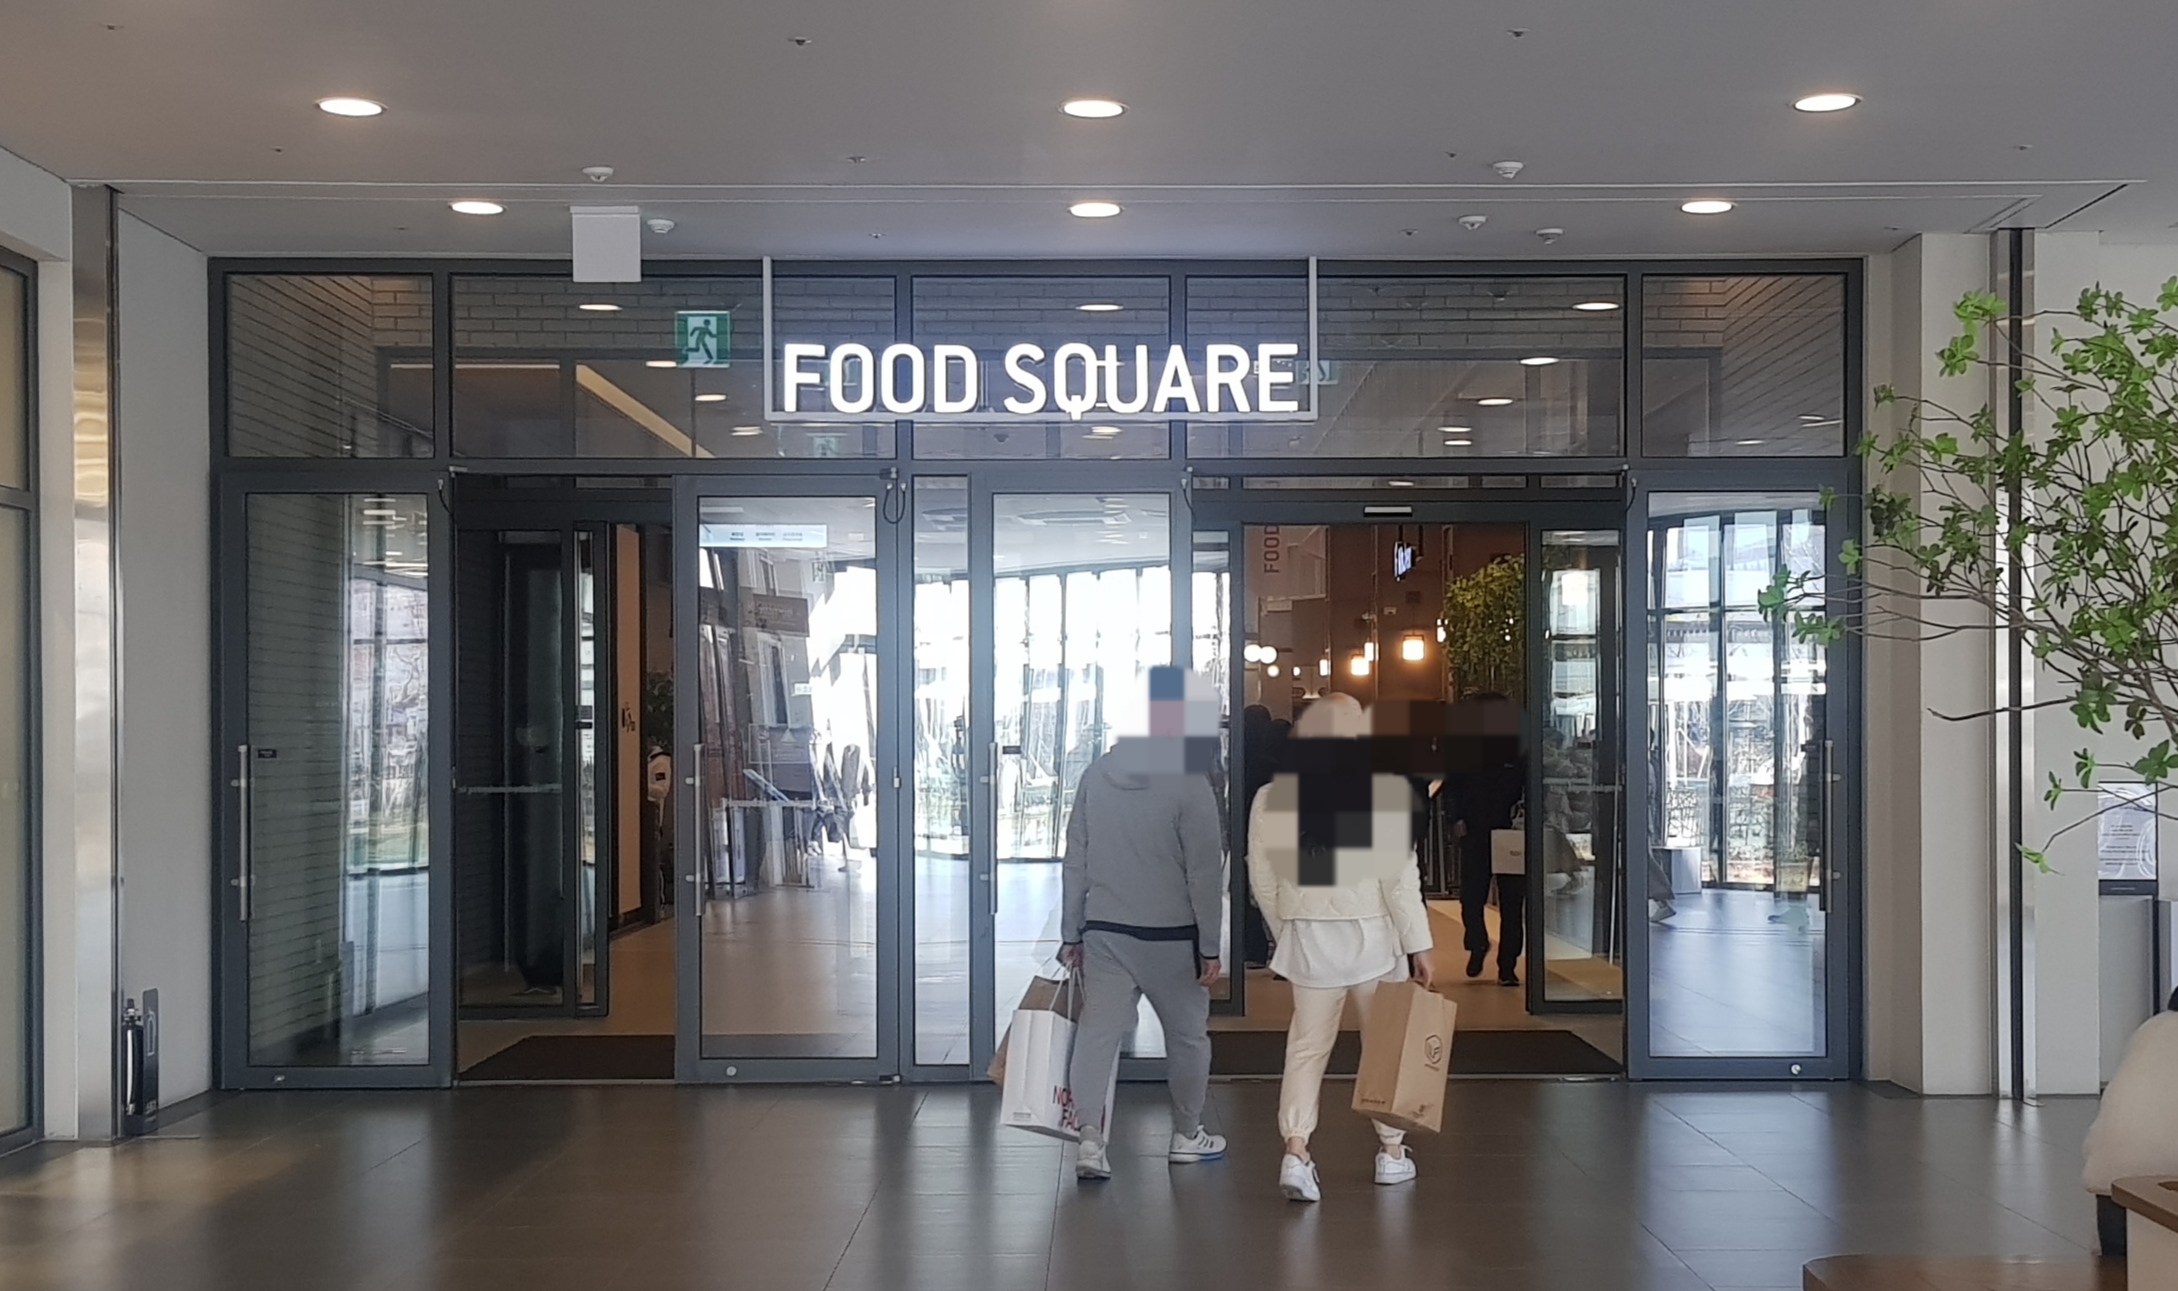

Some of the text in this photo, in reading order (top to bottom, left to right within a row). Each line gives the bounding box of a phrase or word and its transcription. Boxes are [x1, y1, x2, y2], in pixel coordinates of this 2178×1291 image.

[785, 343, 1299, 421] FOOD SQUARE
[1264, 525, 1280, 574] FOOD
